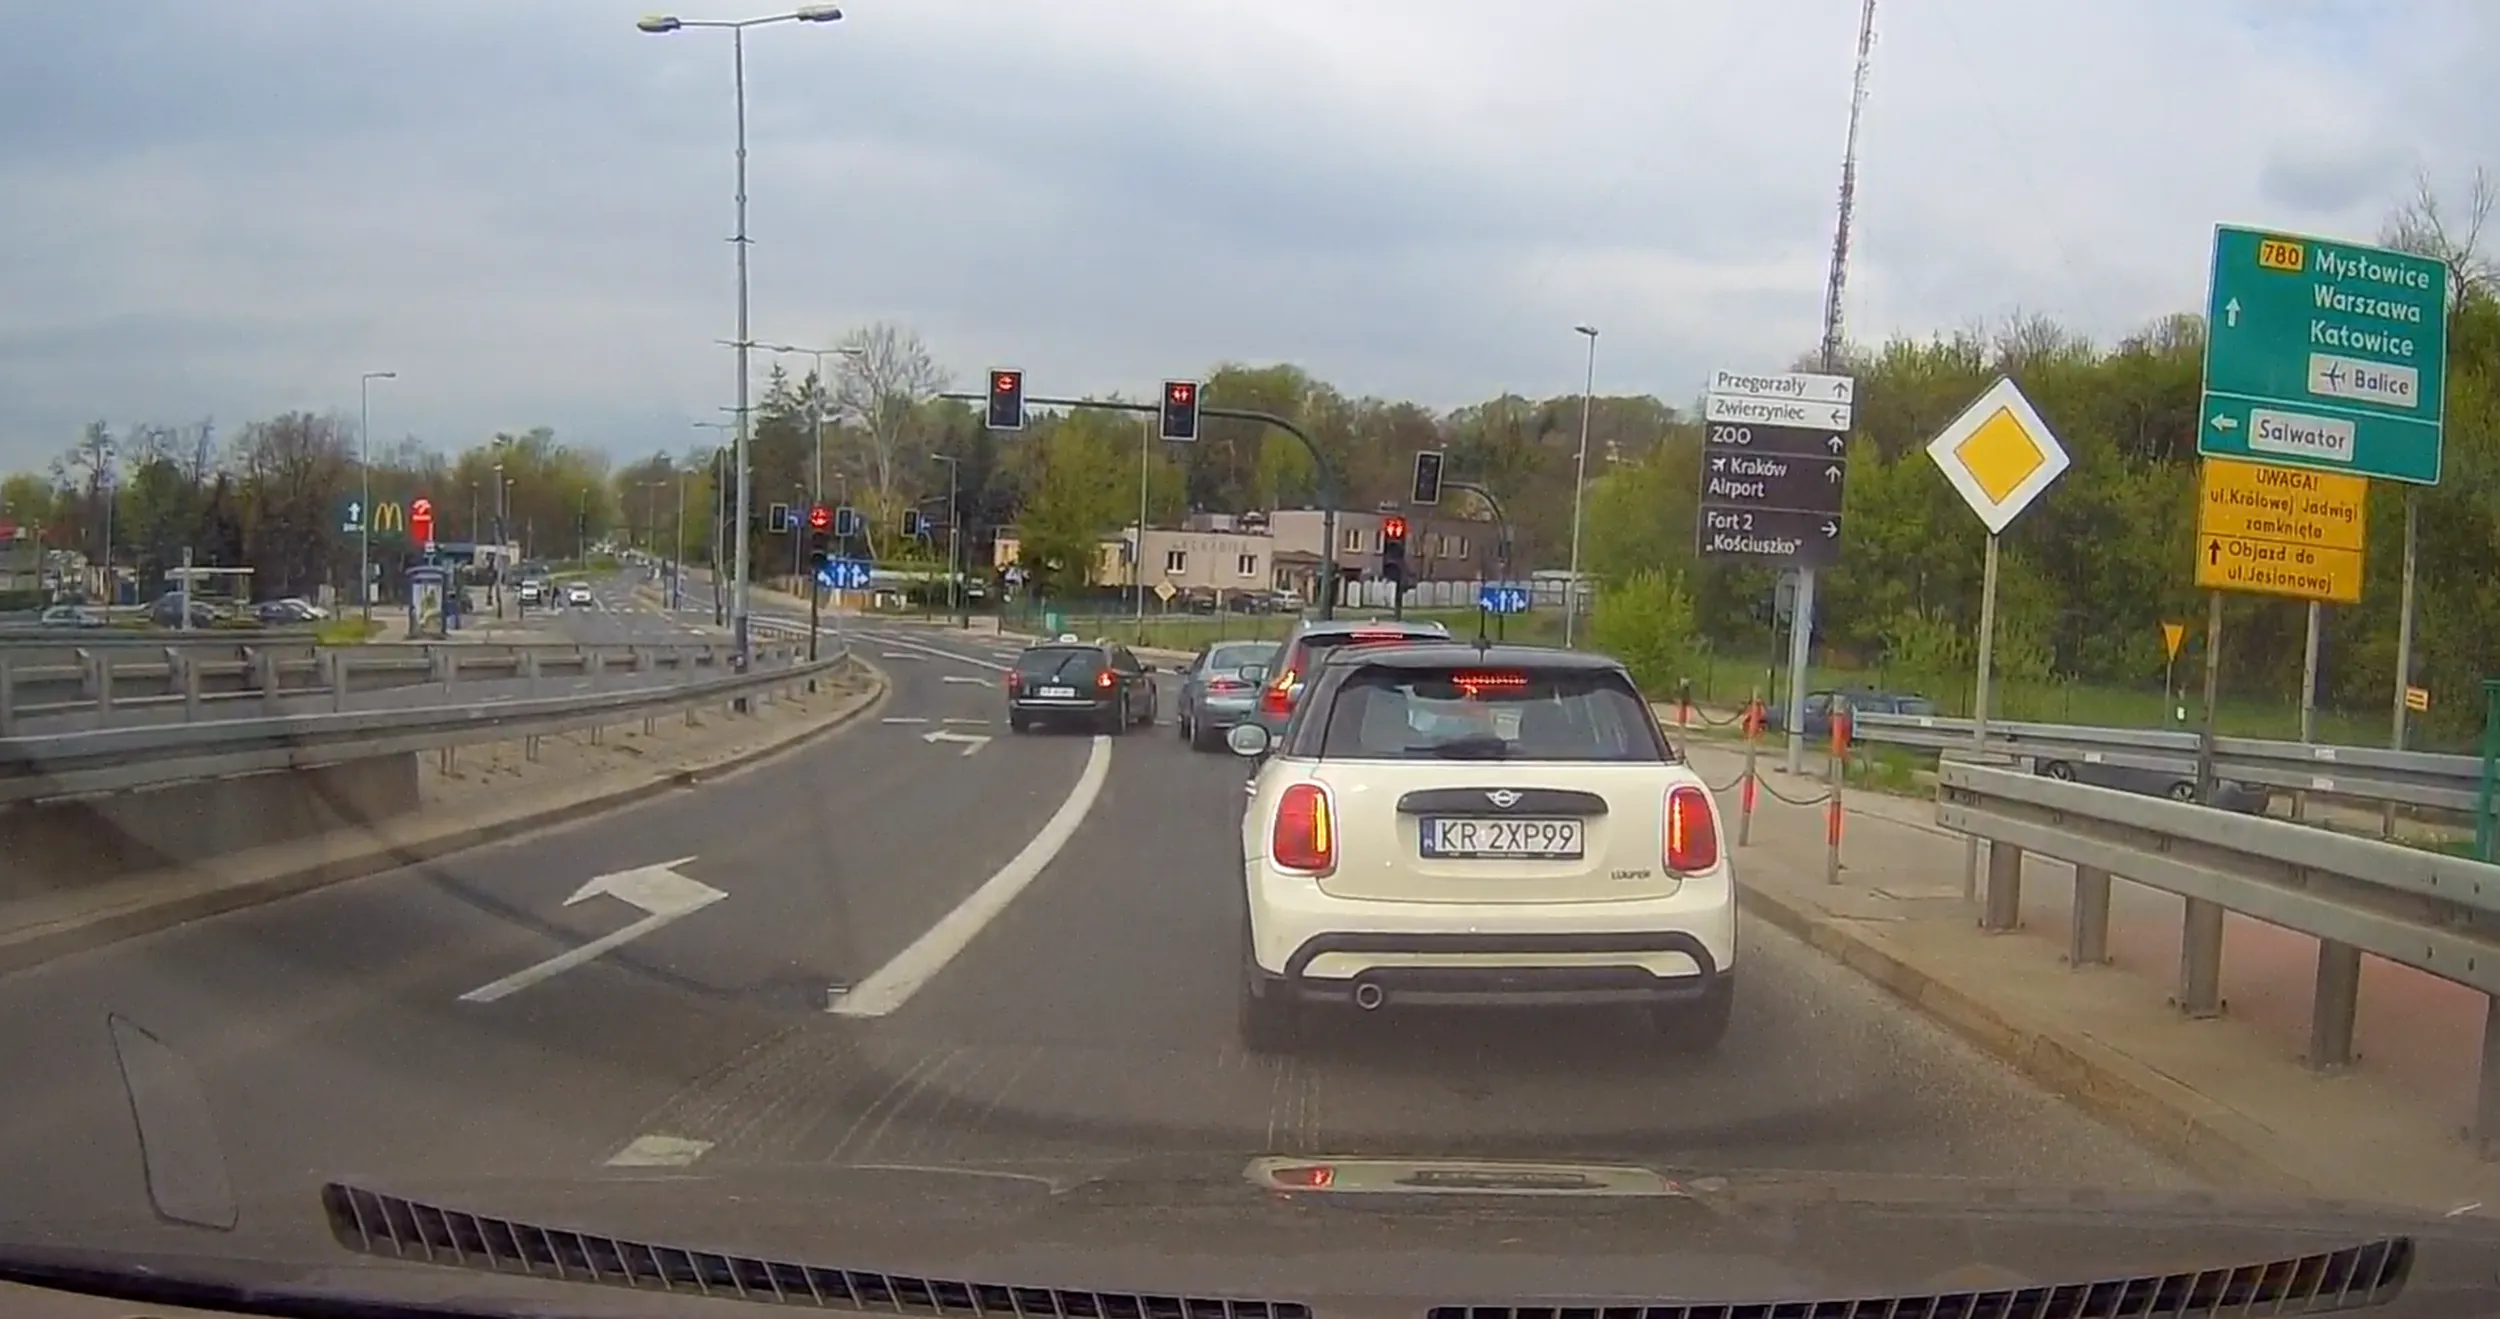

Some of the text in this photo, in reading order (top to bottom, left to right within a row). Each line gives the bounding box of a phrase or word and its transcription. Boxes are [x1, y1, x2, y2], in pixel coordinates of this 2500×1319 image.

[2264, 244, 2300, 266] 780
[2315, 248, 2430, 289] Mysłowice
[2313, 283, 2421, 323] Warszawa
[2310, 319, 2414, 357] Katowice
[1718, 371, 1807, 395] Przegorzały
[2354, 369, 2409, 396] Balice
[1715, 399, 1805, 421] Zwierzyniec
[1712, 426, 1752, 445] ZOO
[2258, 418, 2345, 450] Salwator
[1731, 457, 1788, 477] Kraków
[1708, 478, 1765, 499] Airport
[2256, 468, 2319, 492] UWAGA!
[1707, 511, 1753, 531] Fort 2
[2302, 501, 2358, 523] Jadwigi
[2245, 517, 2323, 541] zamknięta
[2228, 540, 2315, 565] Objazd do
[1441, 822, 1575, 850] KR 2XP99
